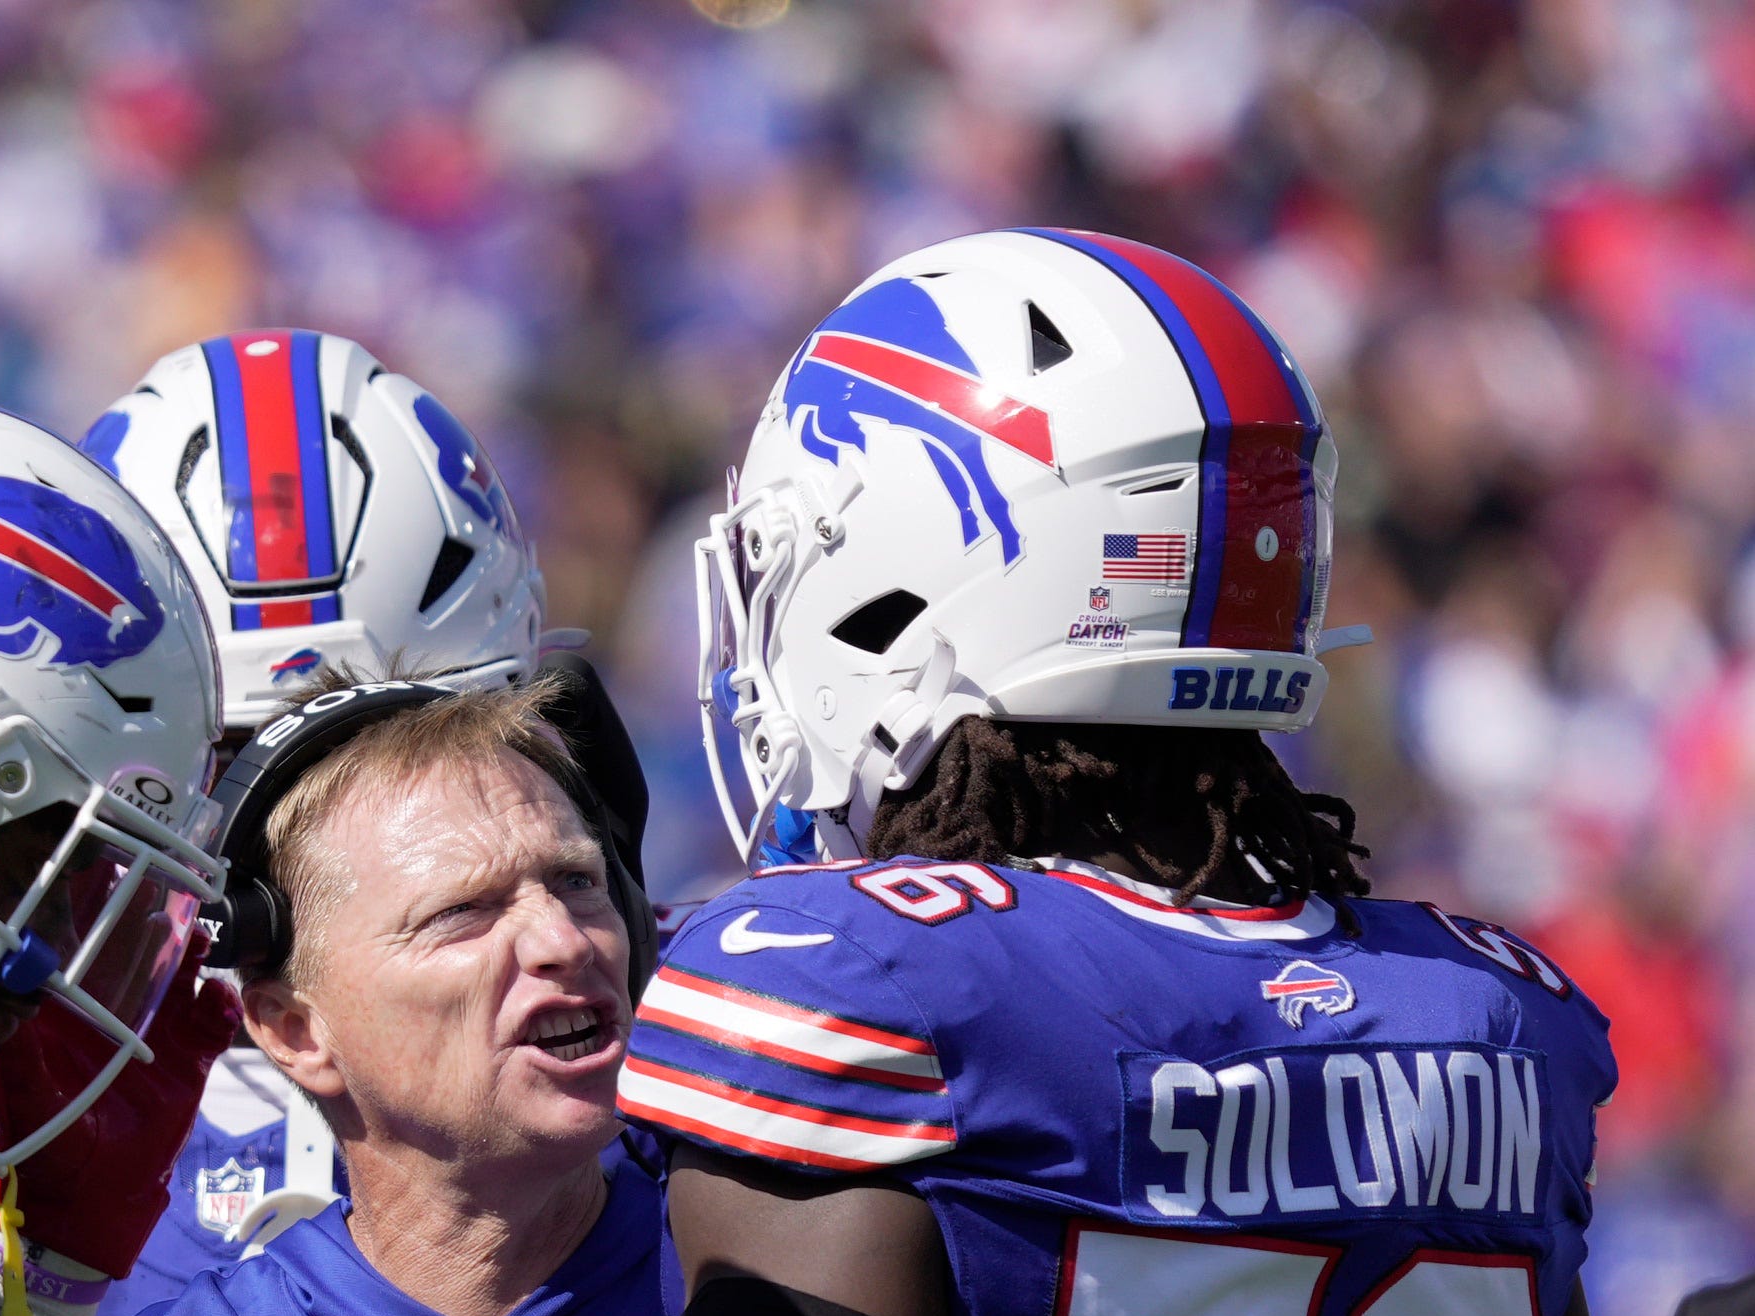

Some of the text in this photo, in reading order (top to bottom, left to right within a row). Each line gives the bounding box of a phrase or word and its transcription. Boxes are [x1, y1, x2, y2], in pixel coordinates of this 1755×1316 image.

[1091, 596, 1109, 609] NFL
[1068, 623, 1127, 640] CATCH
[1078, 614, 1120, 623] CRUCIAL
[1168, 666, 1311, 714] BILLS
[113, 786, 175, 824] OAKLEY
[1144, 1050, 1543, 1217] SOLOMON
